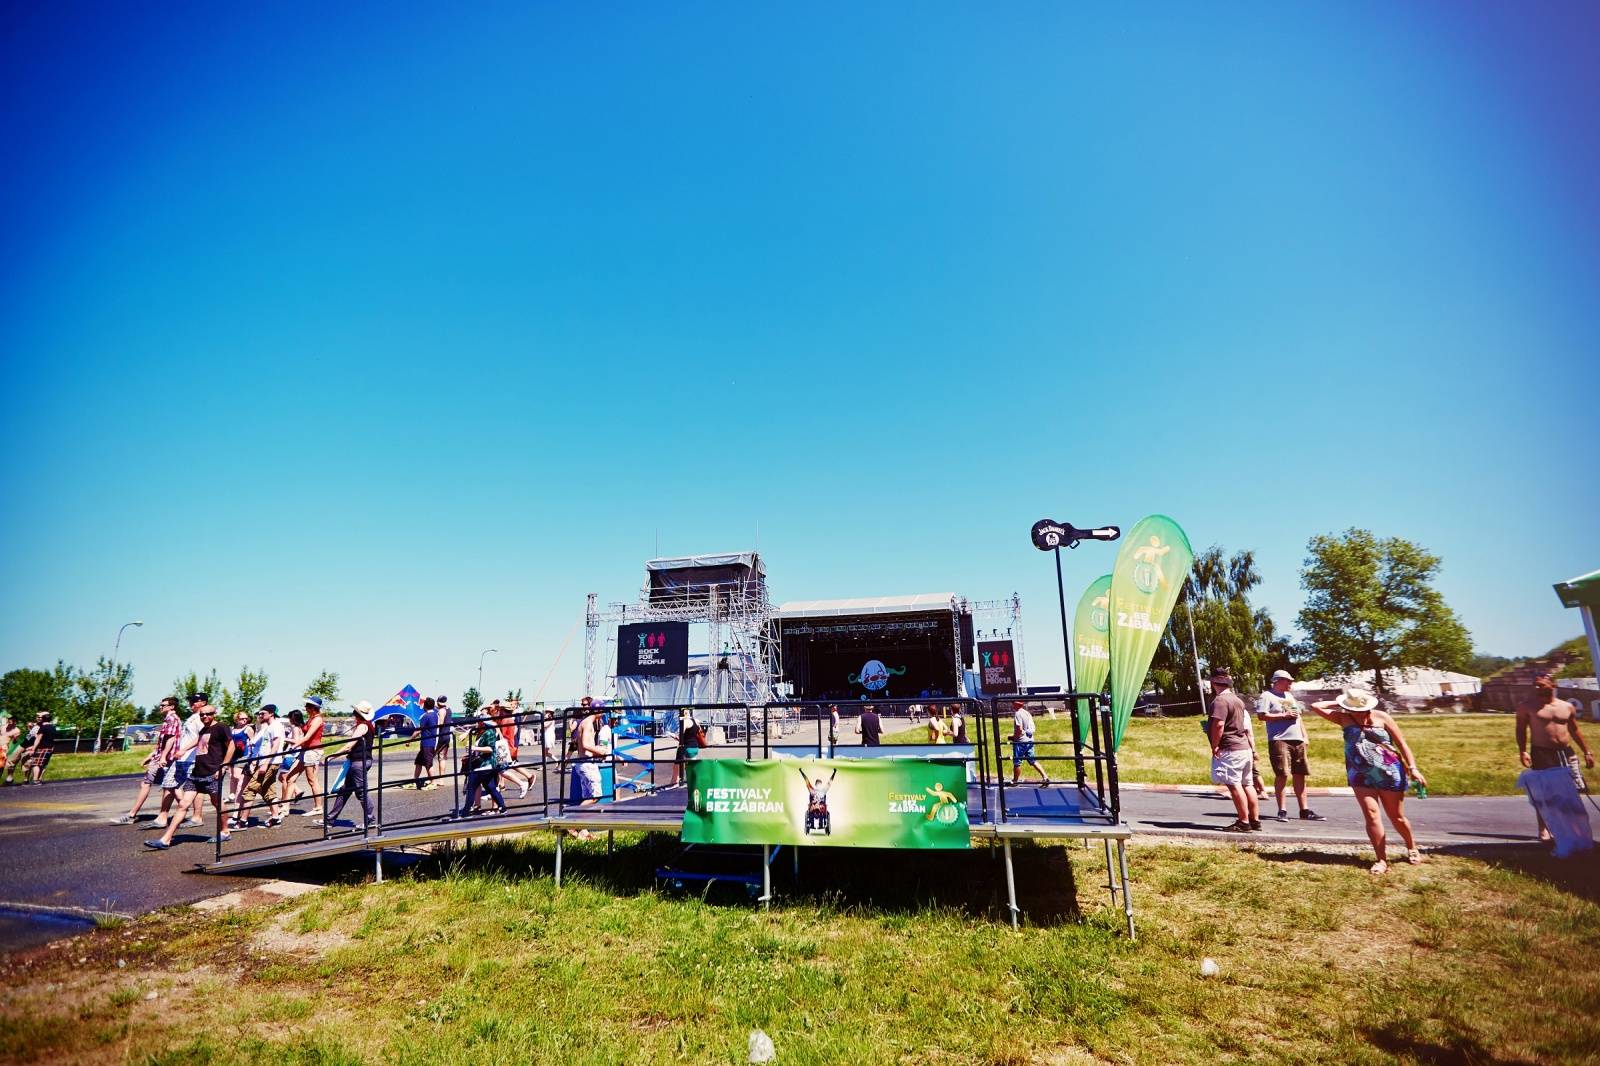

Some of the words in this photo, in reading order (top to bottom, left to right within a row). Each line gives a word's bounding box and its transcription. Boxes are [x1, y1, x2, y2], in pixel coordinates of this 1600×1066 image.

[706, 788, 772, 800] FESTIVALY
[888, 792, 927, 801] FESTIVALY
[706, 801, 730, 813] BEZ
[731, 799, 784, 813] ZÁBRAN
